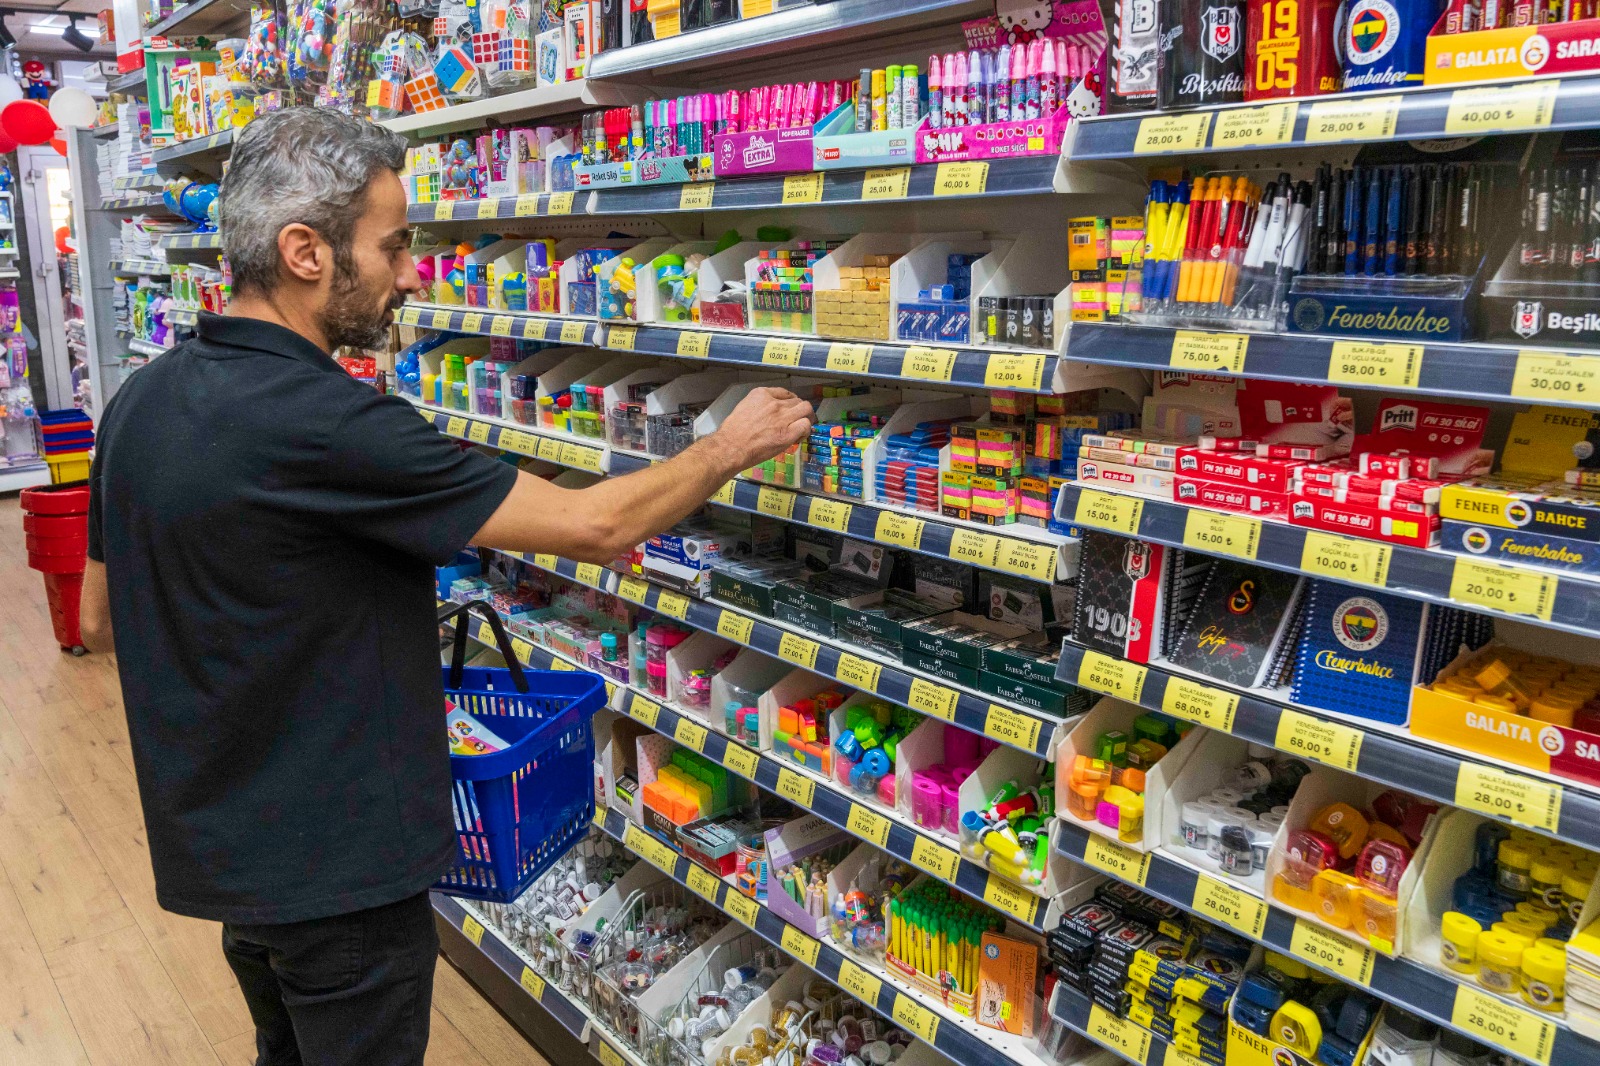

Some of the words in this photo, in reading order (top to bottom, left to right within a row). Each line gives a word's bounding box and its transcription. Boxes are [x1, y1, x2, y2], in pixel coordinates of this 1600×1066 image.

[1261, 0, 1299, 41] 19
[964, 26, 996, 39] HELLO
[967, 35, 997, 48] KITTY
[1455, 48, 1517, 68] GALATA
[1256, 50, 1298, 91] 05
[1461, 110, 1500, 123] 40,00
[1223, 128, 1252, 139] 28,00
[1320, 121, 1353, 133] 28,00
[1147, 135, 1172, 145] 28,00
[724, 144, 731, 152] 36
[747, 150, 771, 162] EXTRA
[833, 358, 850, 366] 12,00
[1182, 351, 1210, 362] 75,00
[912, 363, 930, 372] 13,00
[1341, 364, 1375, 376] 98,00
[994, 372, 1015, 380] 12,00
[1530, 378, 1571, 391] 30,00
[1384, 409, 1415, 424] Pritt
[1423, 416, 1439, 424] PN
[1440, 417, 1452, 426] 30
[1453, 418, 1478, 430] SİLGİ
[1542, 413, 1588, 428] FENER
[1083, 467, 1096, 475] Pritt
[1182, 458, 1196, 467] Pritt
[1224, 465, 1242, 477] SİLGİ
[1180, 485, 1195, 495] Pritt
[1225, 493, 1243, 504] SİLGİ
[1455, 499, 1499, 515] FENER
[814, 513, 830, 522] 15,00
[1086, 509, 1109, 520] 15,00
[1295, 504, 1313, 516] Pritt
[1324, 512, 1336, 521] PN
[1337, 514, 1349, 522] 30
[1349, 515, 1370, 527] SİLGİ
[1196, 532, 1223, 544] 15,00
[957, 546, 977, 557] 23,00
[1008, 557, 1029, 568] 36,00
[1315, 556, 1347, 570] 10,00
[1466, 584, 1503, 599] 20,00
[1084, 604, 1142, 641] 1903
[1315, 650, 1394, 679] Fenerbahçe
[1090, 673, 1113, 688] 68,00
[915, 696, 933, 708] 27,00
[1175, 701, 1202, 716] 68,00
[992, 723, 1012, 736] 35,00
[1465, 711, 1532, 743] GALATA
[1290, 736, 1320, 753] 68,00
[1474, 792, 1512, 809] 28,00
[653, 812, 671, 829] OSAKA
[854, 821, 869, 833] 15,00
[919, 854, 937, 867] 29,00
[1095, 852, 1118, 867] 15,00
[993, 893, 1012, 908] 12,00
[1205, 897, 1231, 916] 28,00
[786, 941, 801, 953] 30,00
[1303, 942, 1333, 962] 28,00
[898, 1011, 915, 1026] 20,00
[1468, 1013, 1504, 1036] 28,00
[1096, 1025, 1120, 1043] 28,00
[1231, 1027, 1269, 1056] FENER
